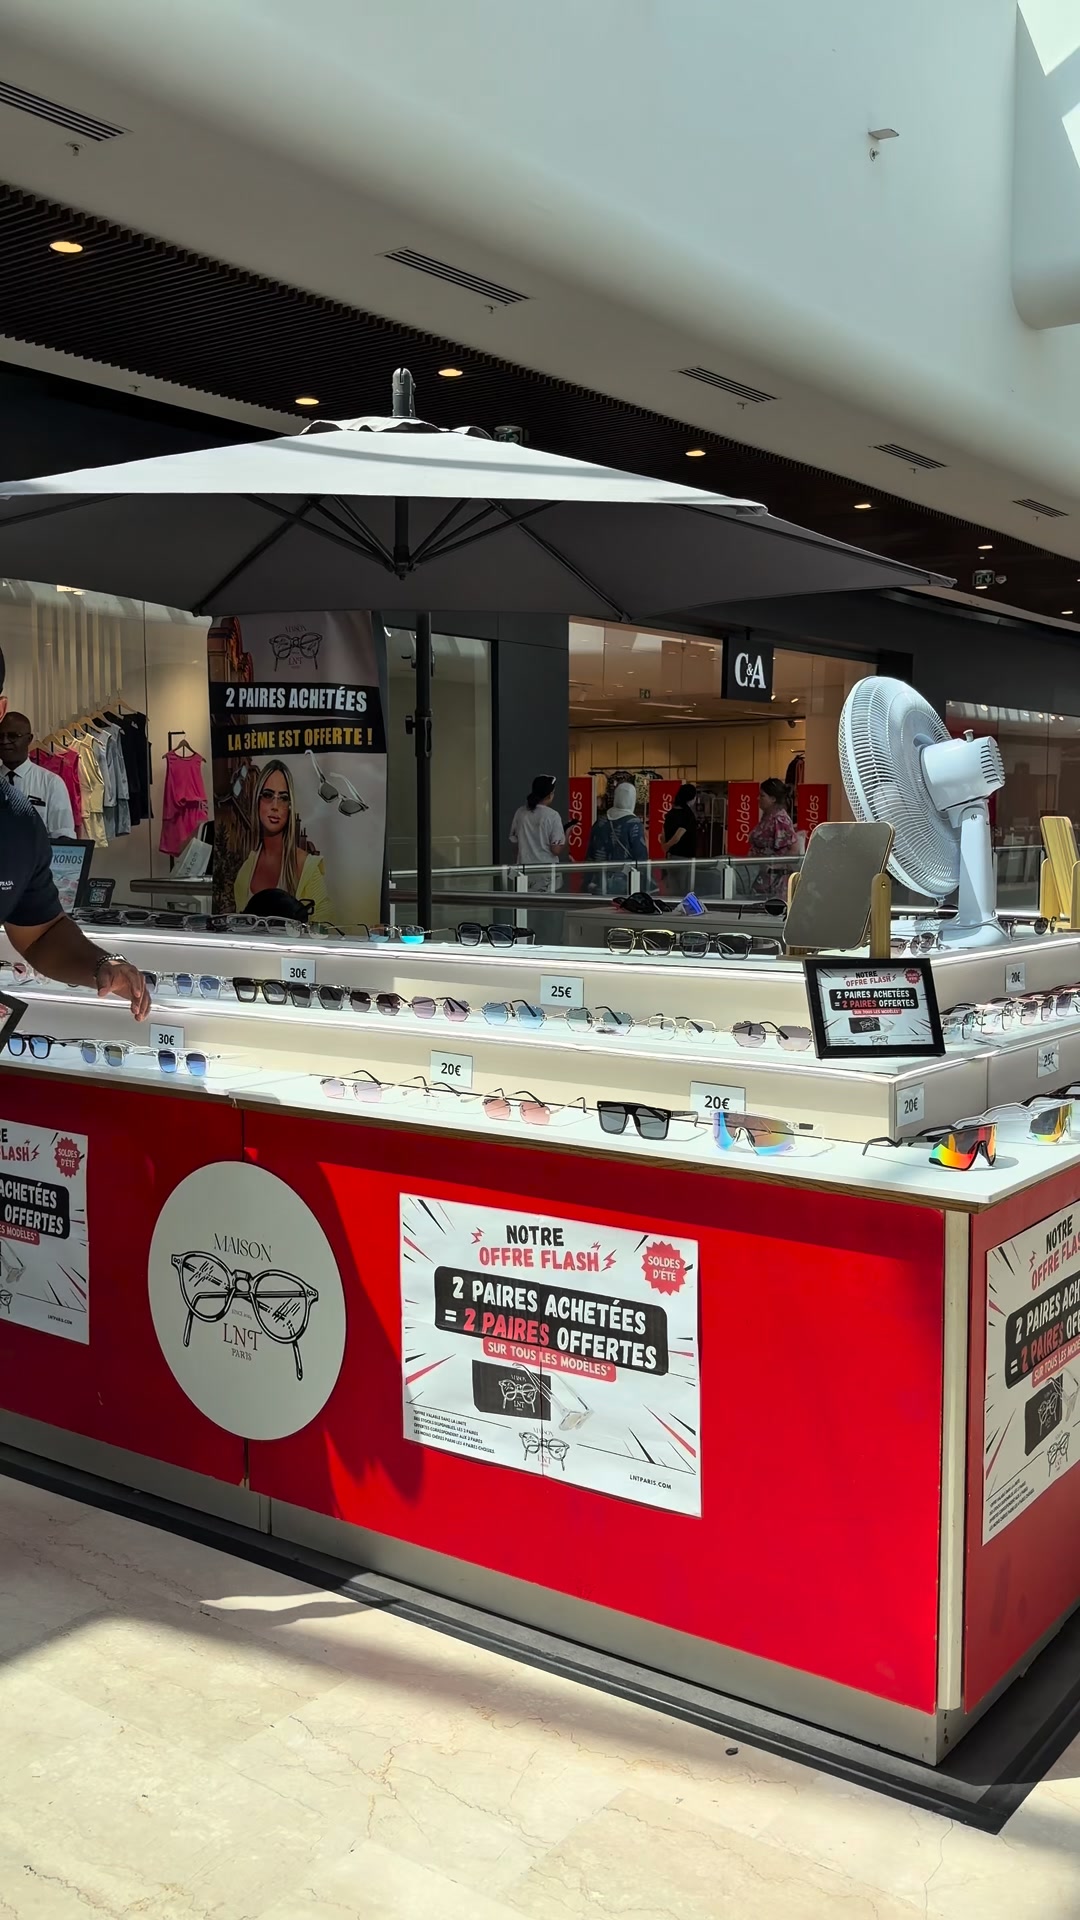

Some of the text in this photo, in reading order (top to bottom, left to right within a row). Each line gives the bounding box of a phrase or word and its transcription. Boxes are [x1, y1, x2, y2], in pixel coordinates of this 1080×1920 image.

[735, 652, 767, 689] C&A
[225, 686, 367, 713] 2 PAIRES ACHETÉES
[227, 734, 242, 752] LA
[243, 729, 276, 750] 3ÈME
[278, 729, 301, 748] EST
[303, 727, 363, 747] OFFERTE
[736, 794, 751, 843] Soldes
[52, 854, 84, 865] KONOS
[289, 967, 307, 979] 30€
[845, 976, 891, 987] OFFRE FLASH
[855, 970, 878, 979] NOTRE
[1010, 971, 1021, 983] 20€
[551, 985, 572, 999] 25€
[836, 988, 910, 999] 2 PAIRES ACHETÉES
[842, 1000, 848, 1008] 2
[849, 999, 877, 1008] PAIRES
[878, 999, 915, 1007] OFFERTES
[158, 1033, 175, 1046] 30€
[441, 1062, 462, 1077] 20€
[704, 1095, 731, 1110] 20€
[904, 1097, 919, 1114] 20€
[0, 1145, 30, 1162] LASH
[58, 1147, 78, 1159] SOLDES
[4, 1203, 64, 1235] OFFERTES
[505, 1224, 565, 1247] NOTRE
[1045, 1213, 1073, 1255] NOTRE
[213, 1232, 272, 1263] MAISON
[479, 1246, 600, 1272] OFFRE FLASH
[647, 1254, 681, 1270] SOLDES
[652, 1266, 677, 1282] D'ÉTÉ
[1031, 1249, 1060, 1292] OFFRE
[452, 1276, 647, 1335] 2 PAIRES ACHETÉES
[1015, 1278, 1080, 1344] 2 PAIRES ACH
[223, 1322, 263, 1351] LNT
[463, 1308, 476, 1331] 2
[482, 1312, 550, 1346] PAIRES
[556, 1327, 657, 1370] OFFERTES
[231, 1348, 252, 1361] PARIS
[488, 1341, 507, 1355] SUR
[509, 1345, 537, 1361] TOUS
[541, 1351, 558, 1365] LES
[1021, 1345, 1029, 1374] 2
[1030, 1321, 1064, 1367] PAIRES
[1034, 1363, 1044, 1382] SUR
[629, 1473, 672, 1490] LNTPARIS.COM
